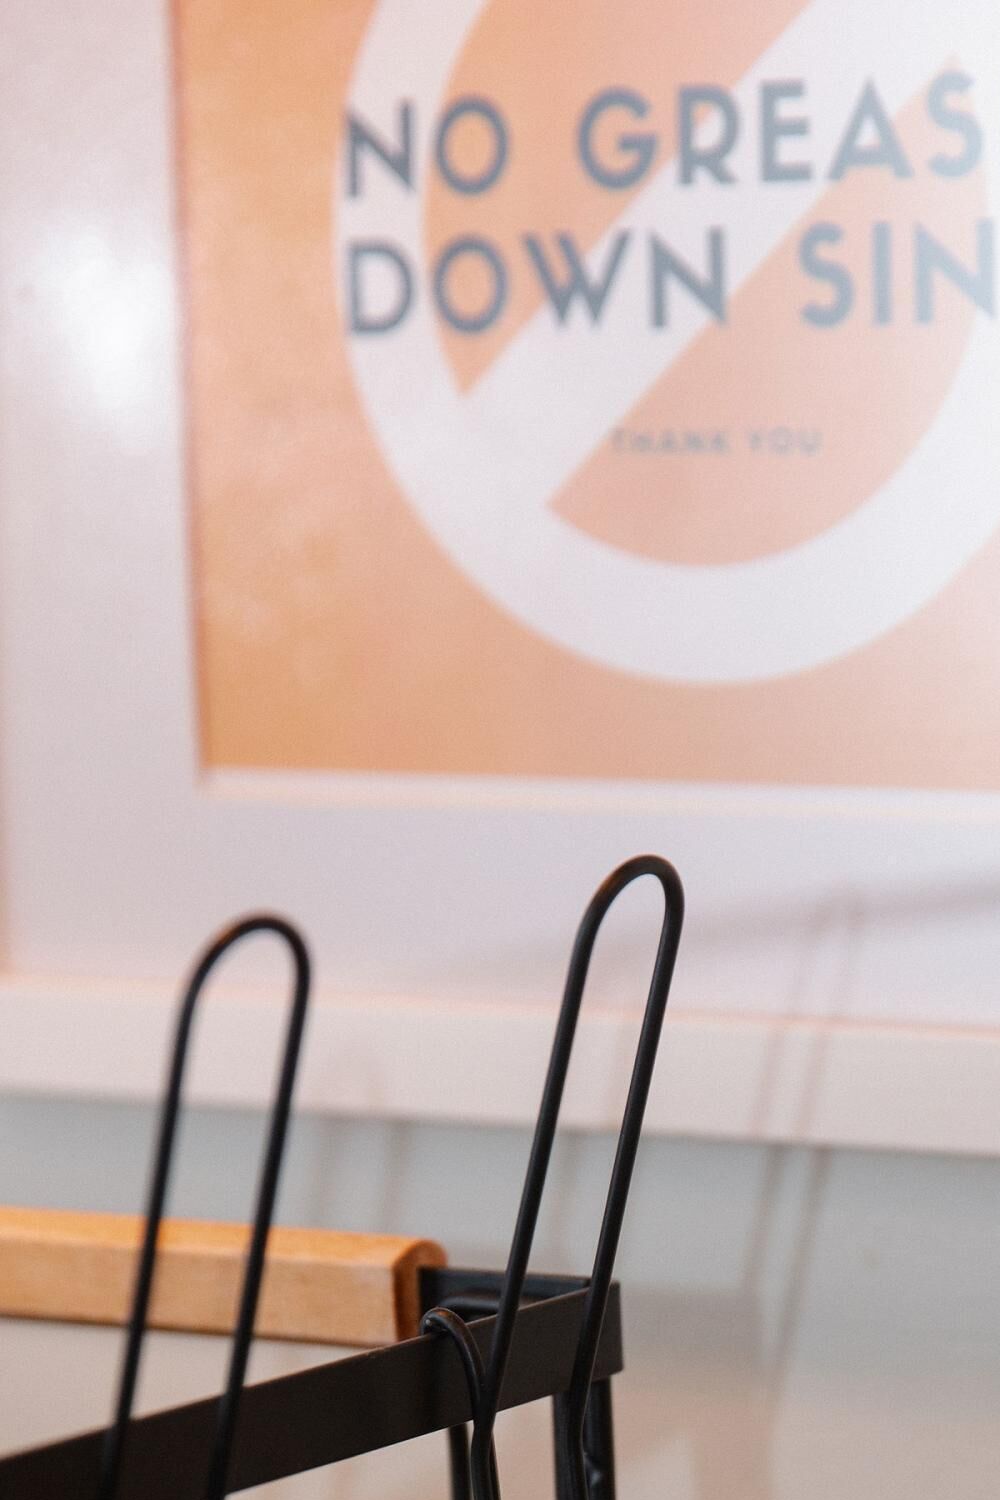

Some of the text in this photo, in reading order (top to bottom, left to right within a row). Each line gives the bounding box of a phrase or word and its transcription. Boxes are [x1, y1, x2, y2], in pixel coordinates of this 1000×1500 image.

[343, 94, 512, 199] NO
[345, 226, 729, 337] DOWN
[610, 425, 824, 456] THANK YOU
